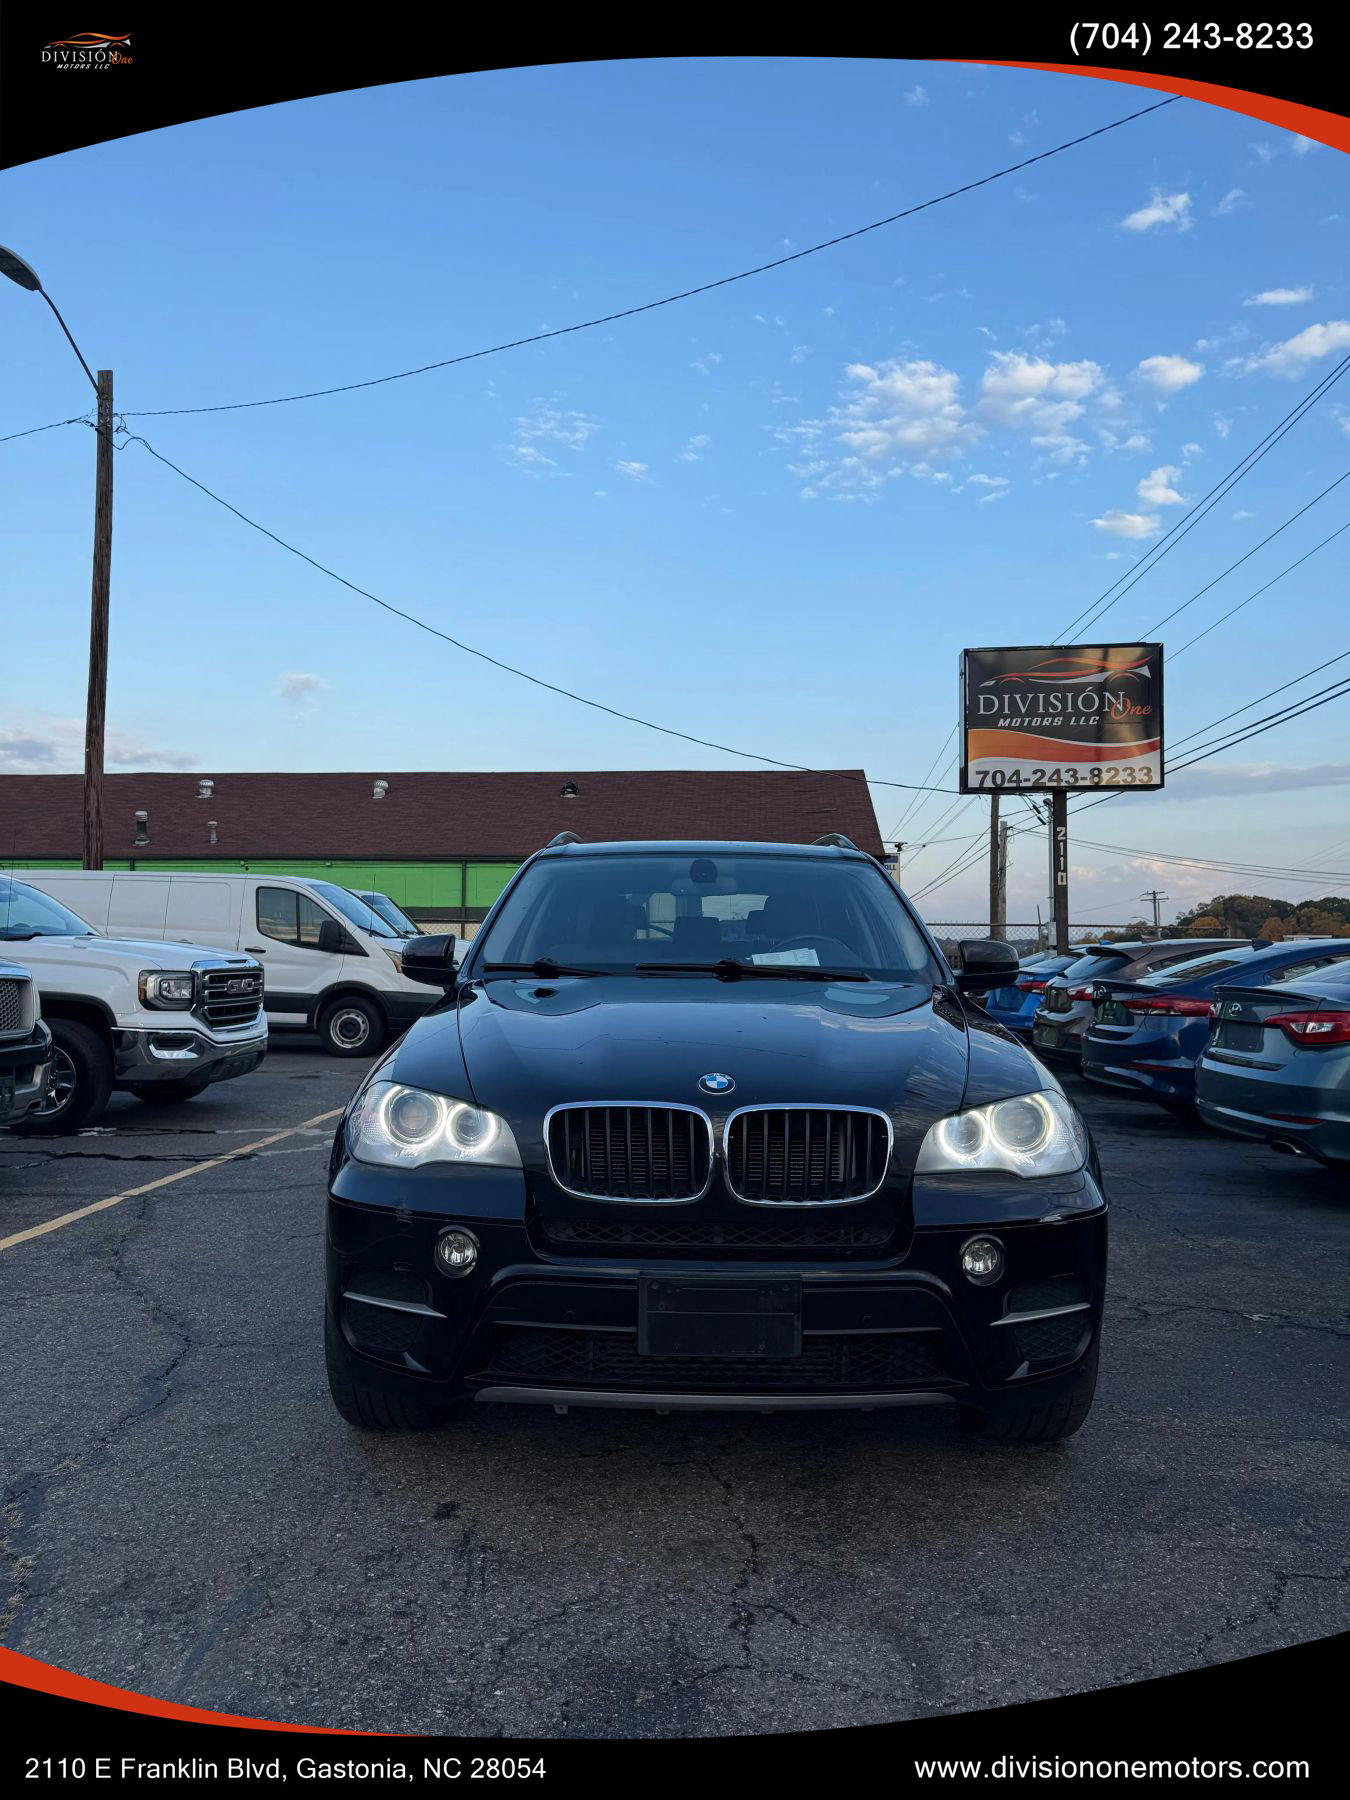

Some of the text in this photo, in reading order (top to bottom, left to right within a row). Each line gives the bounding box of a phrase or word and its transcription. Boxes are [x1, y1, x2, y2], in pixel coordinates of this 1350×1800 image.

[978, 687, 1152, 720] DIVISIÓN One
[998, 715, 1099, 728] MOTORS LLC
[975, 767, 1153, 787] 704-243-8233
[228, 979, 254, 993] GMC
